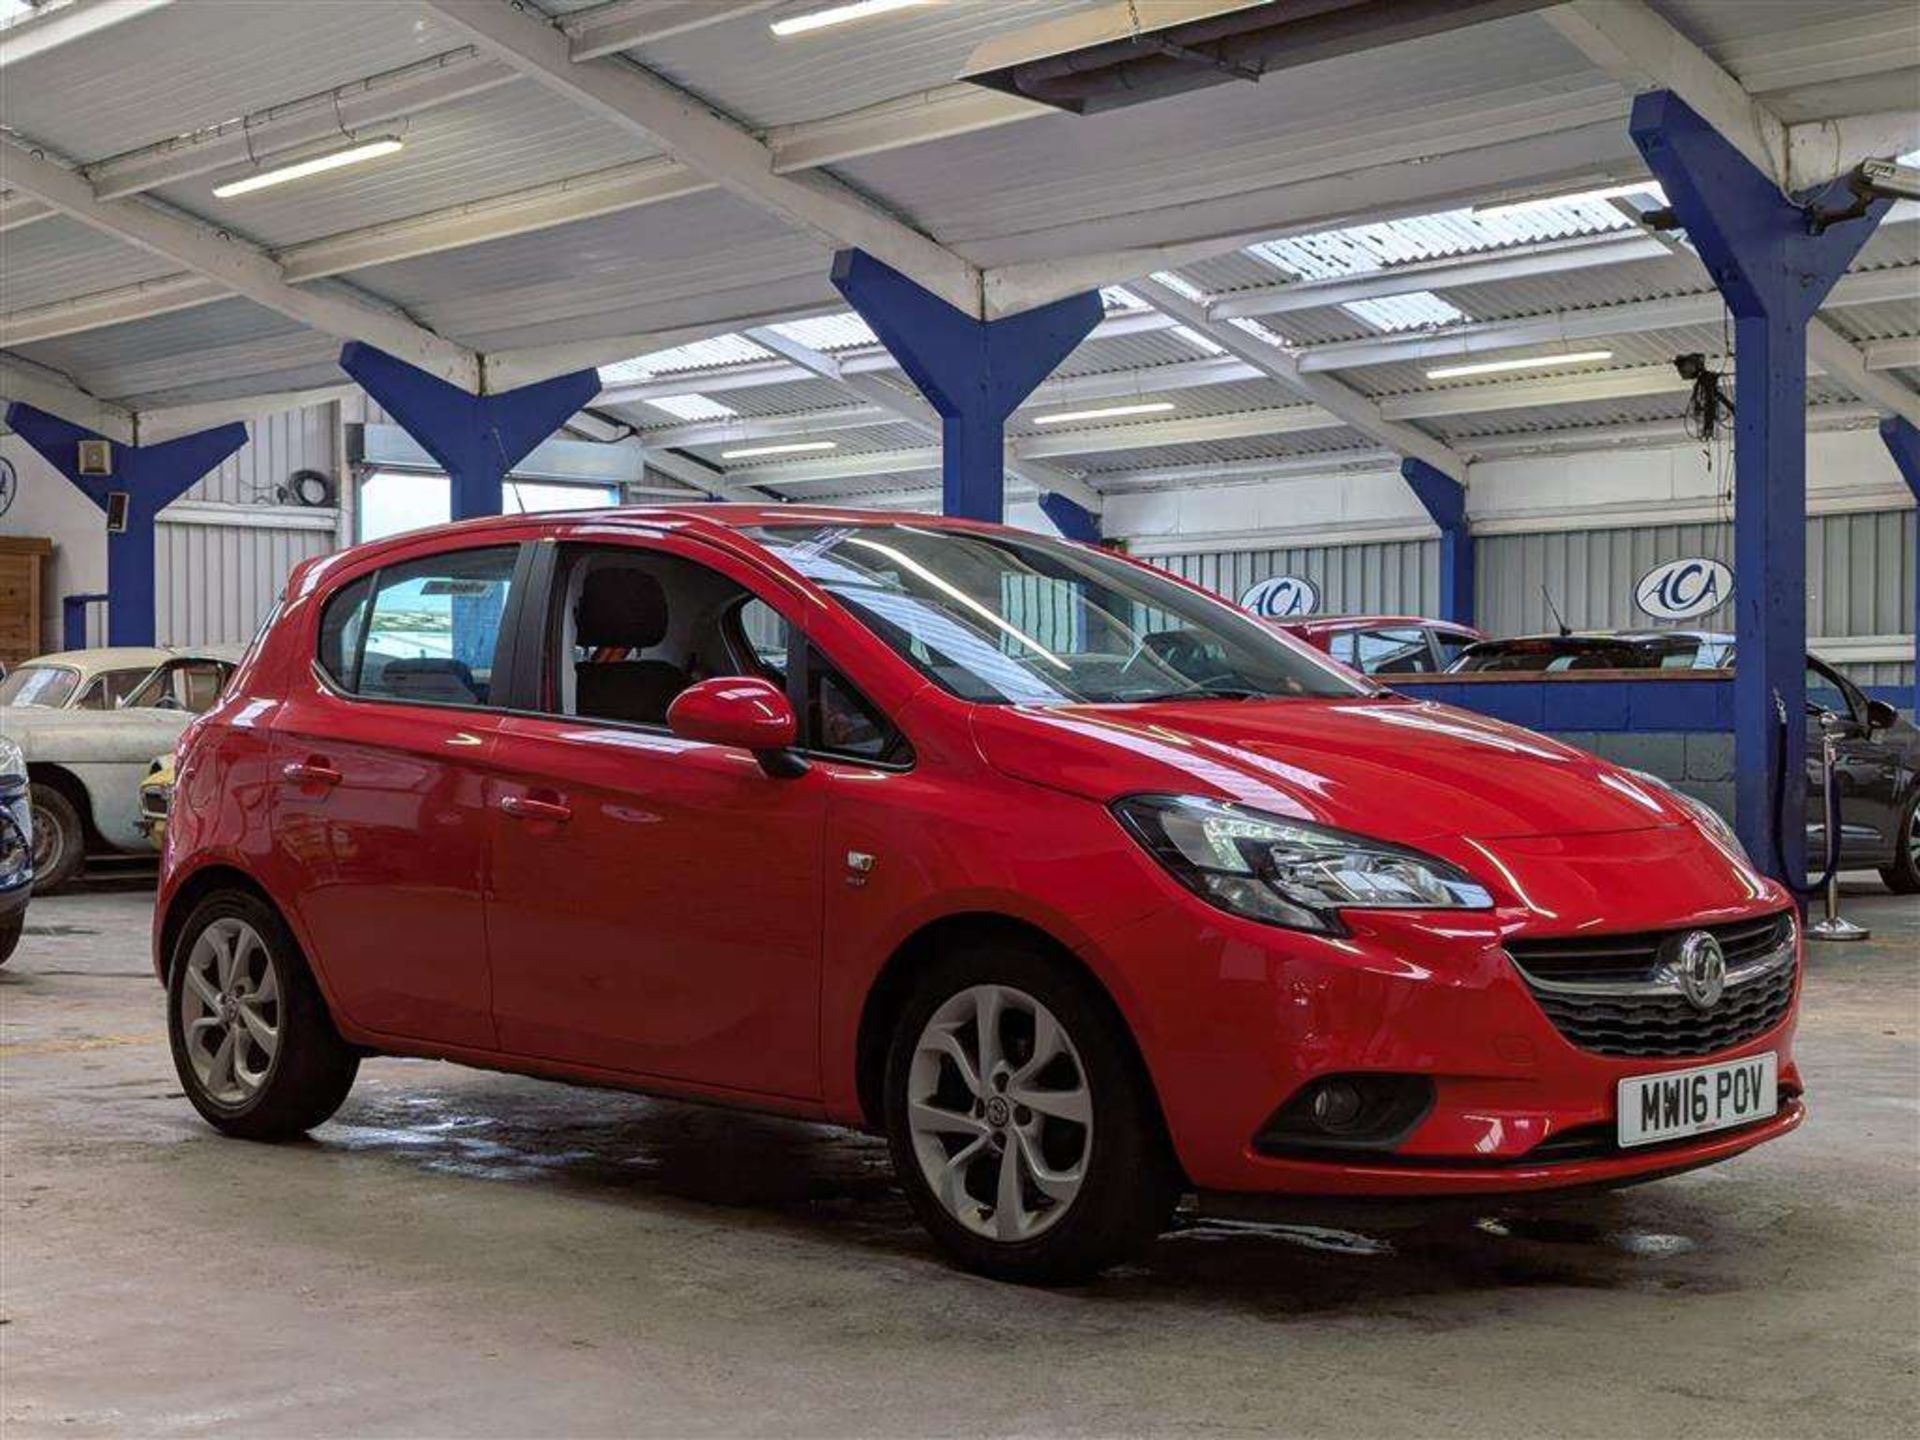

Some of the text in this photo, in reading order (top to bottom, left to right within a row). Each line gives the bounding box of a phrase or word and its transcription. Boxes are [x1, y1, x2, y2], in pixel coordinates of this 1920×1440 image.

[1247, 581, 1302, 617] ACA
[1641, 564, 1719, 611] ACA
[1641, 1063, 1763, 1132] MW16 POV
